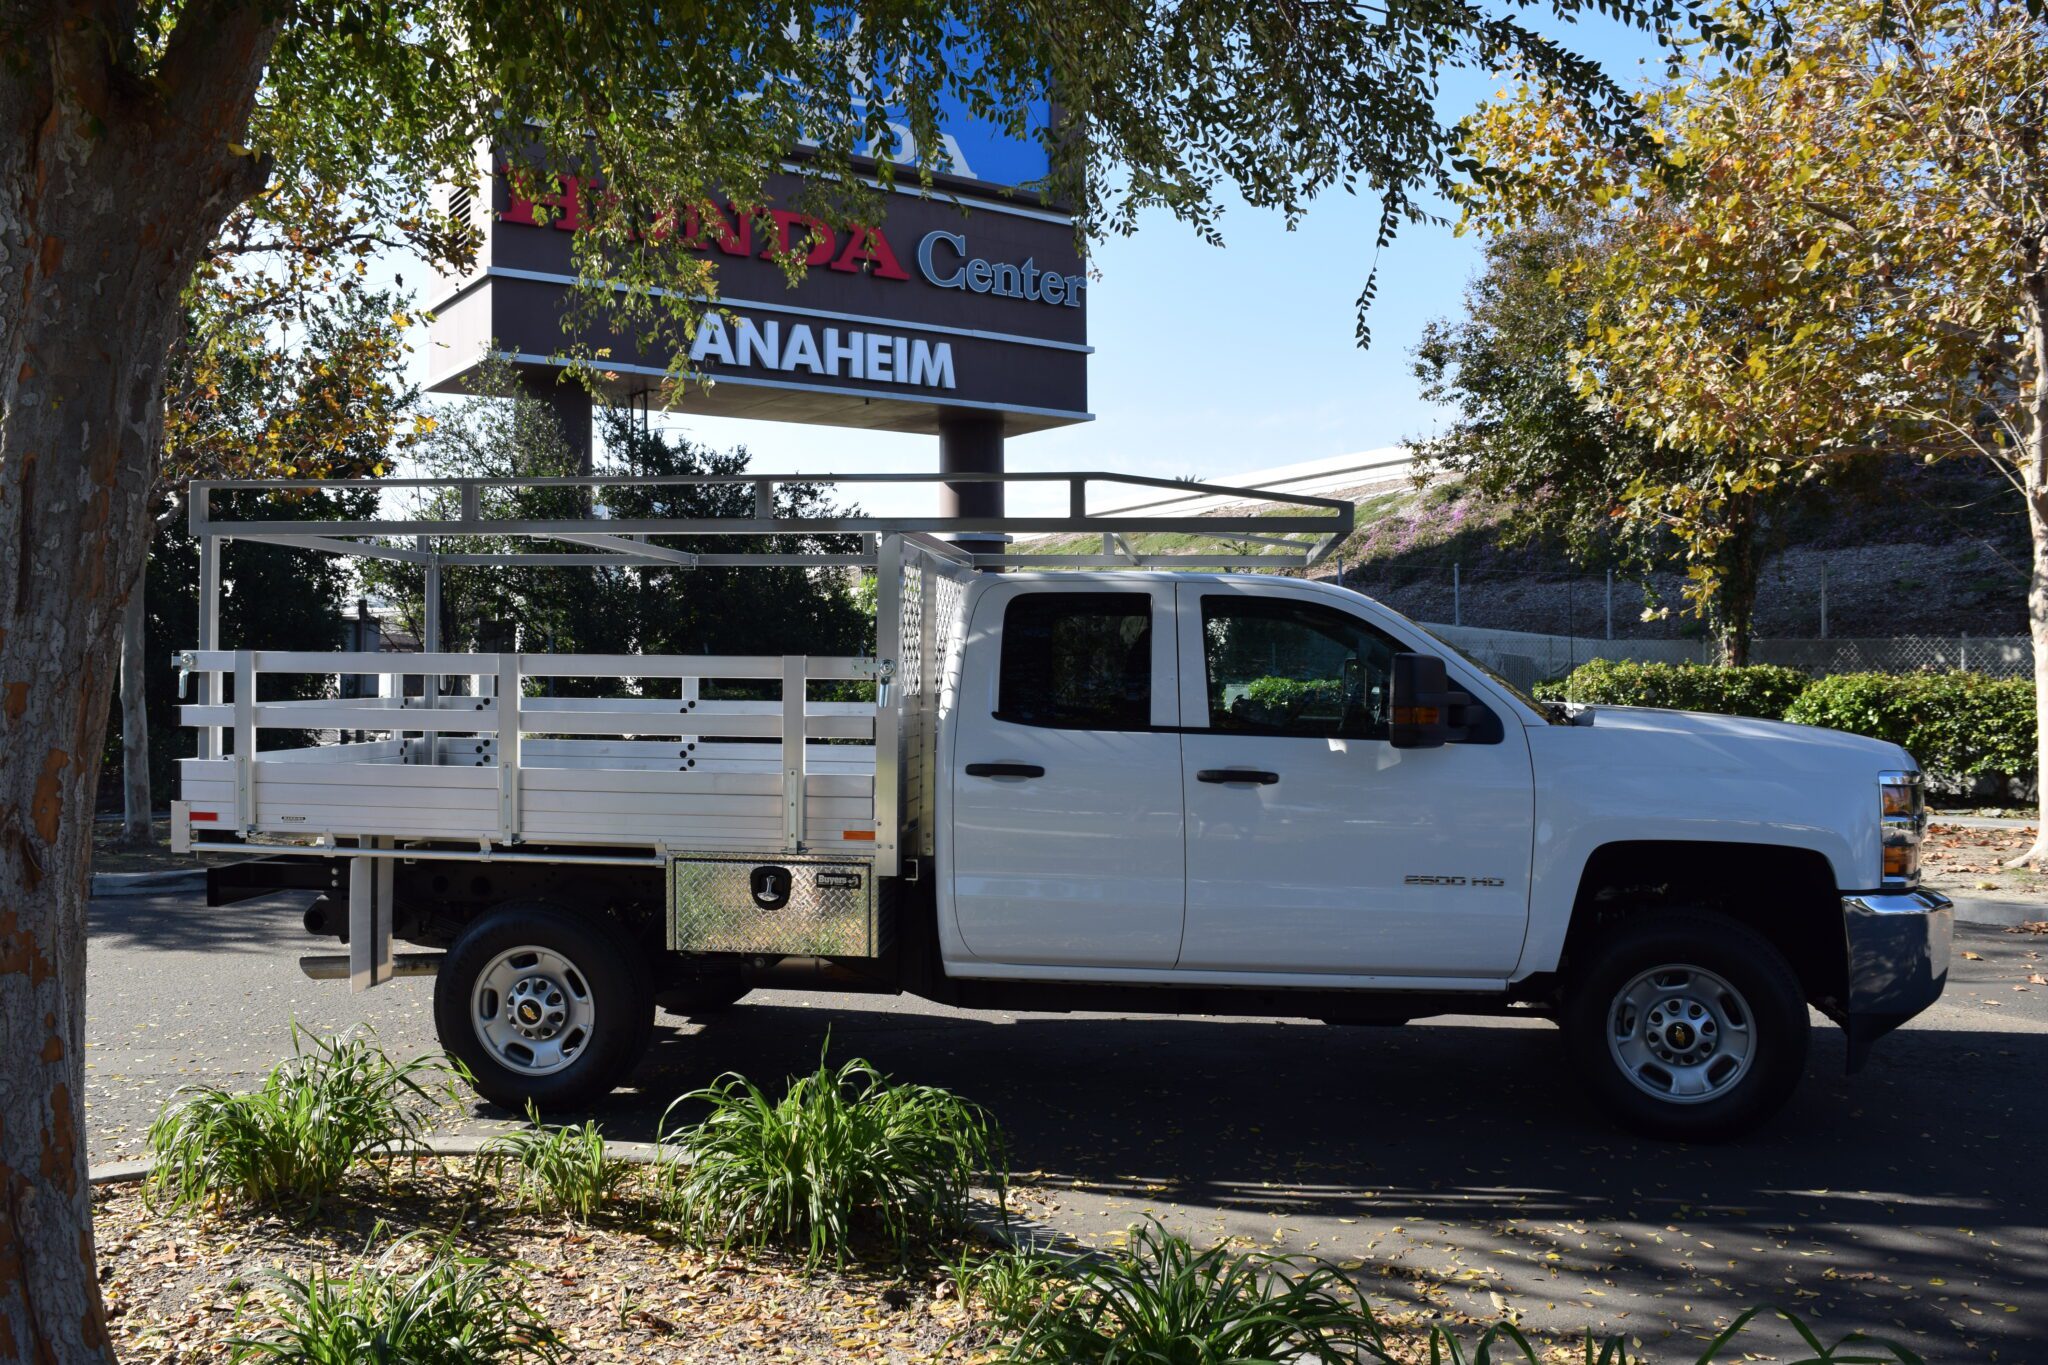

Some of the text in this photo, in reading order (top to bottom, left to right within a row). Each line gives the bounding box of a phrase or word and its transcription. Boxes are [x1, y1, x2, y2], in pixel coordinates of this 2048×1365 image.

[917, 229, 1088, 308] Center
[688, 311, 957, 390] ANAHEIM
[818, 874, 847, 885] Buyers
[1404, 875, 1505, 887] 2500 HD
